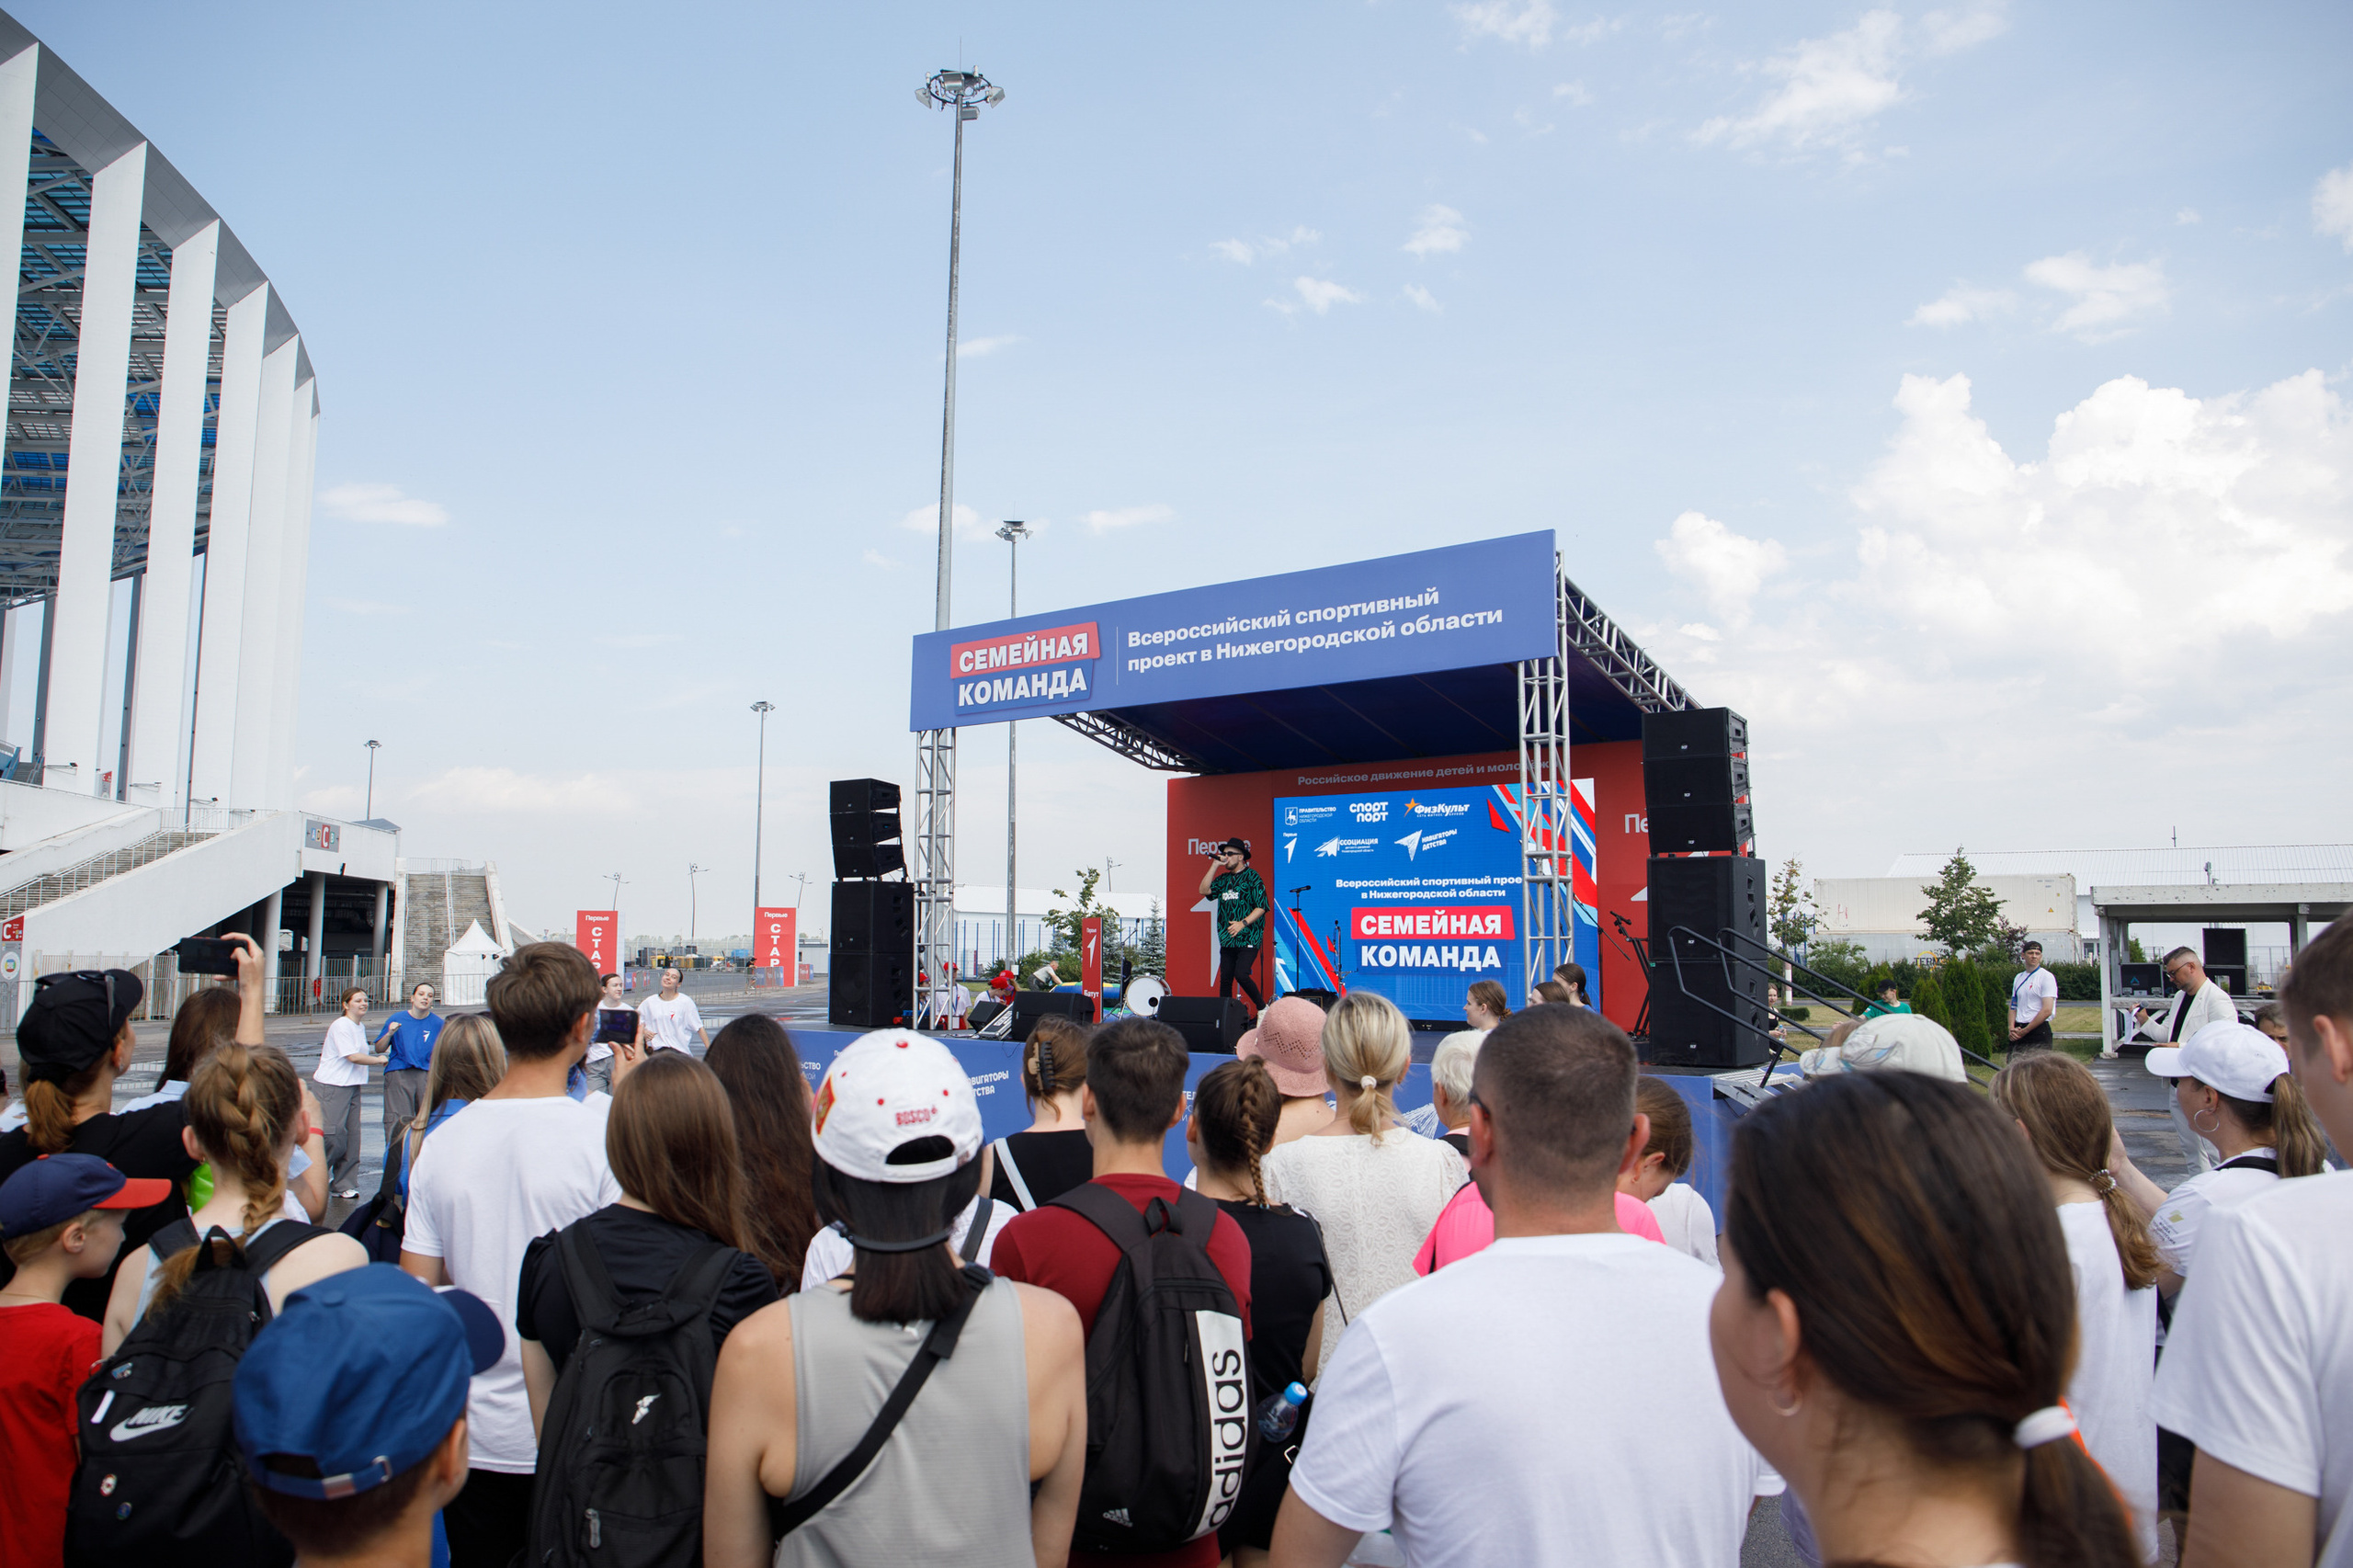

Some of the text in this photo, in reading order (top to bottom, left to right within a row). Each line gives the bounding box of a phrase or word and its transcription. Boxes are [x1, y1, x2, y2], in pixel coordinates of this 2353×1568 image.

[1128, 586, 1439, 648] Всероссийский спортивный
[1128, 608, 1503, 674] проект в Нижегородской области
[959, 632, 1088, 673] СЕМЕЙНАЯ
[958, 667, 1087, 707] КОМАНДА
[1298, 772, 1369, 786] Российское
[1370, 767, 1434, 782] движение
[1435, 765, 1477, 779] детей
[1478, 765, 1487, 774] и
[1415, 802, 1470, 817] ФизКульт
[1421, 828, 1458, 843] НАВИГАТОРЫ
[1422, 838, 1447, 851] ДЕТСТВА
[1336, 875, 1522, 889] Всероссийский спортивный прое
[1369, 888, 1458, 901] Нижегородской
[1458, 888, 1506, 899] области
[1360, 909, 1502, 936] СЕМЕЙНАЯ
[1361, 945, 1501, 972] КОМАНДА
[969, 1070, 1009, 1085] ВИГАТОРЫ
[972, 1085, 995, 1097] ТСТВА
[895, 1108, 931, 1126] BOSCO
[127, 1404, 188, 1426] NIKE
[1209, 1348, 1245, 1528] adidas
